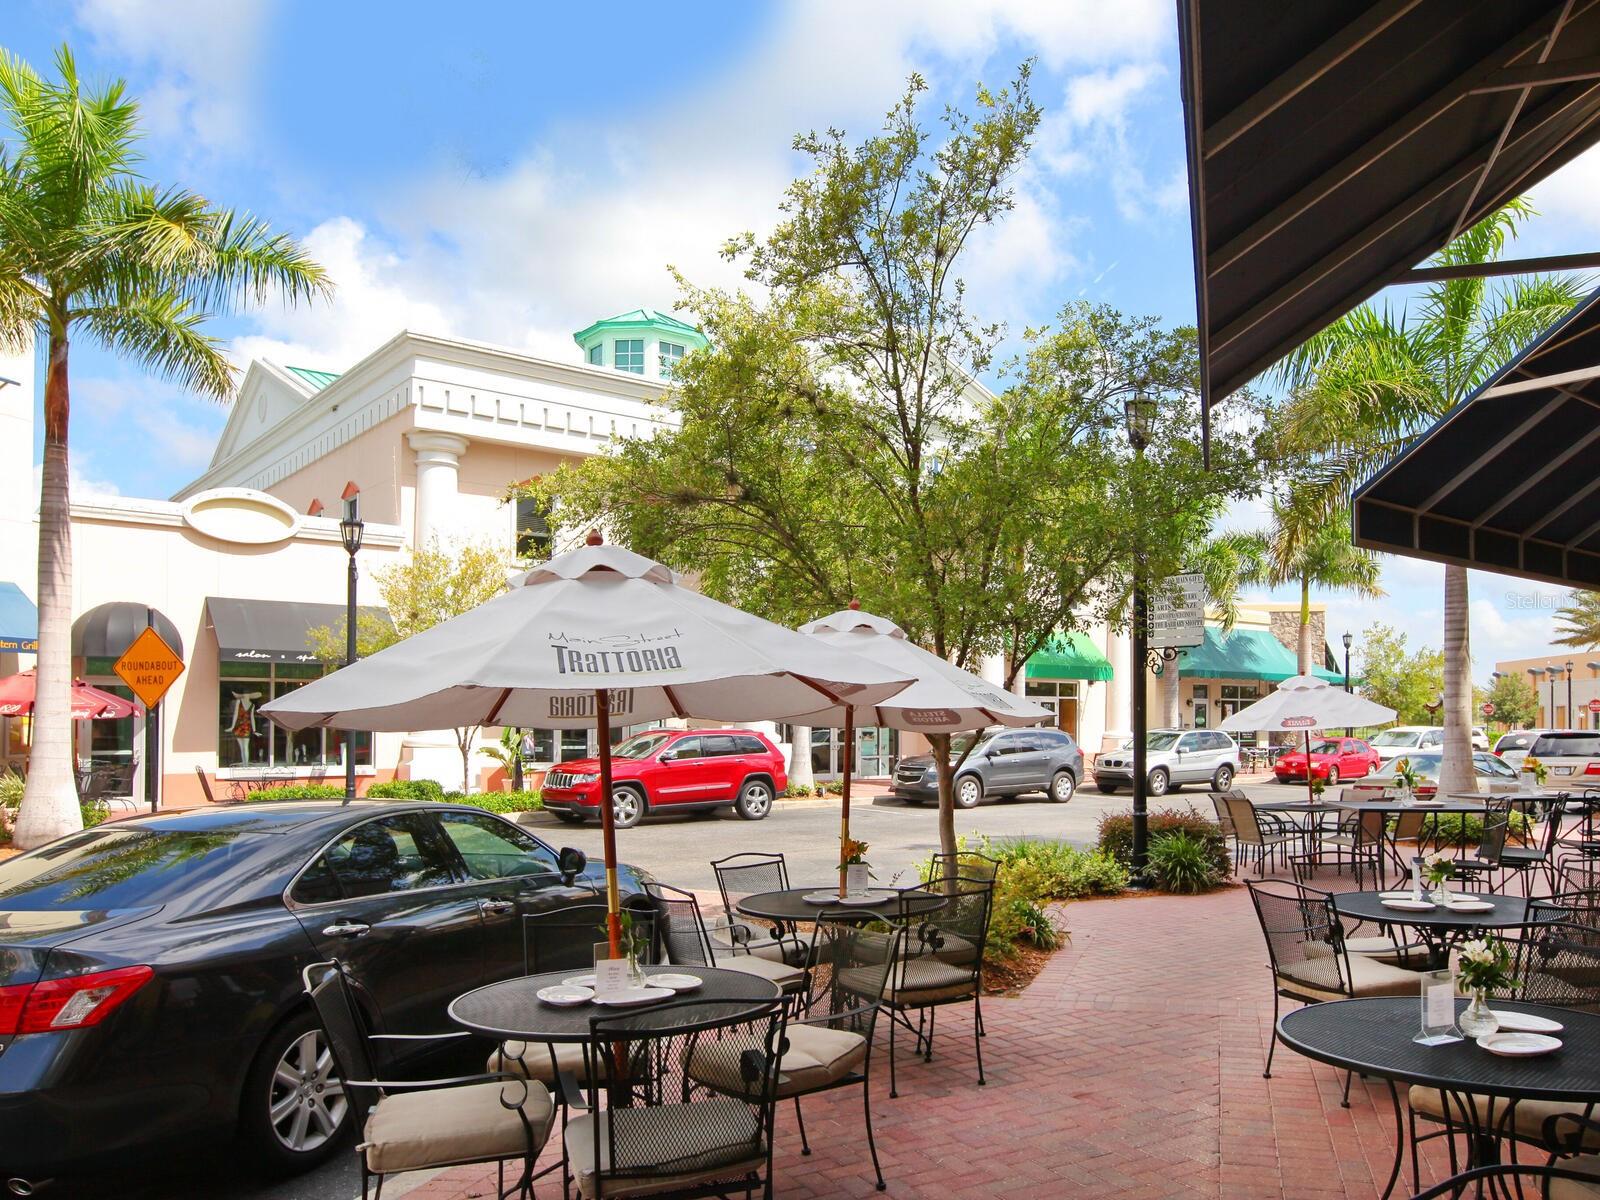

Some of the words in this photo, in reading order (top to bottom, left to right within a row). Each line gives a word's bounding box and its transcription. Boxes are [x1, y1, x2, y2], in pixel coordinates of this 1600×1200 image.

[235, 650, 271, 659] salon
[121, 661, 178, 671] ROUNDABOUT
[136, 675, 164, 685] AHEAD
